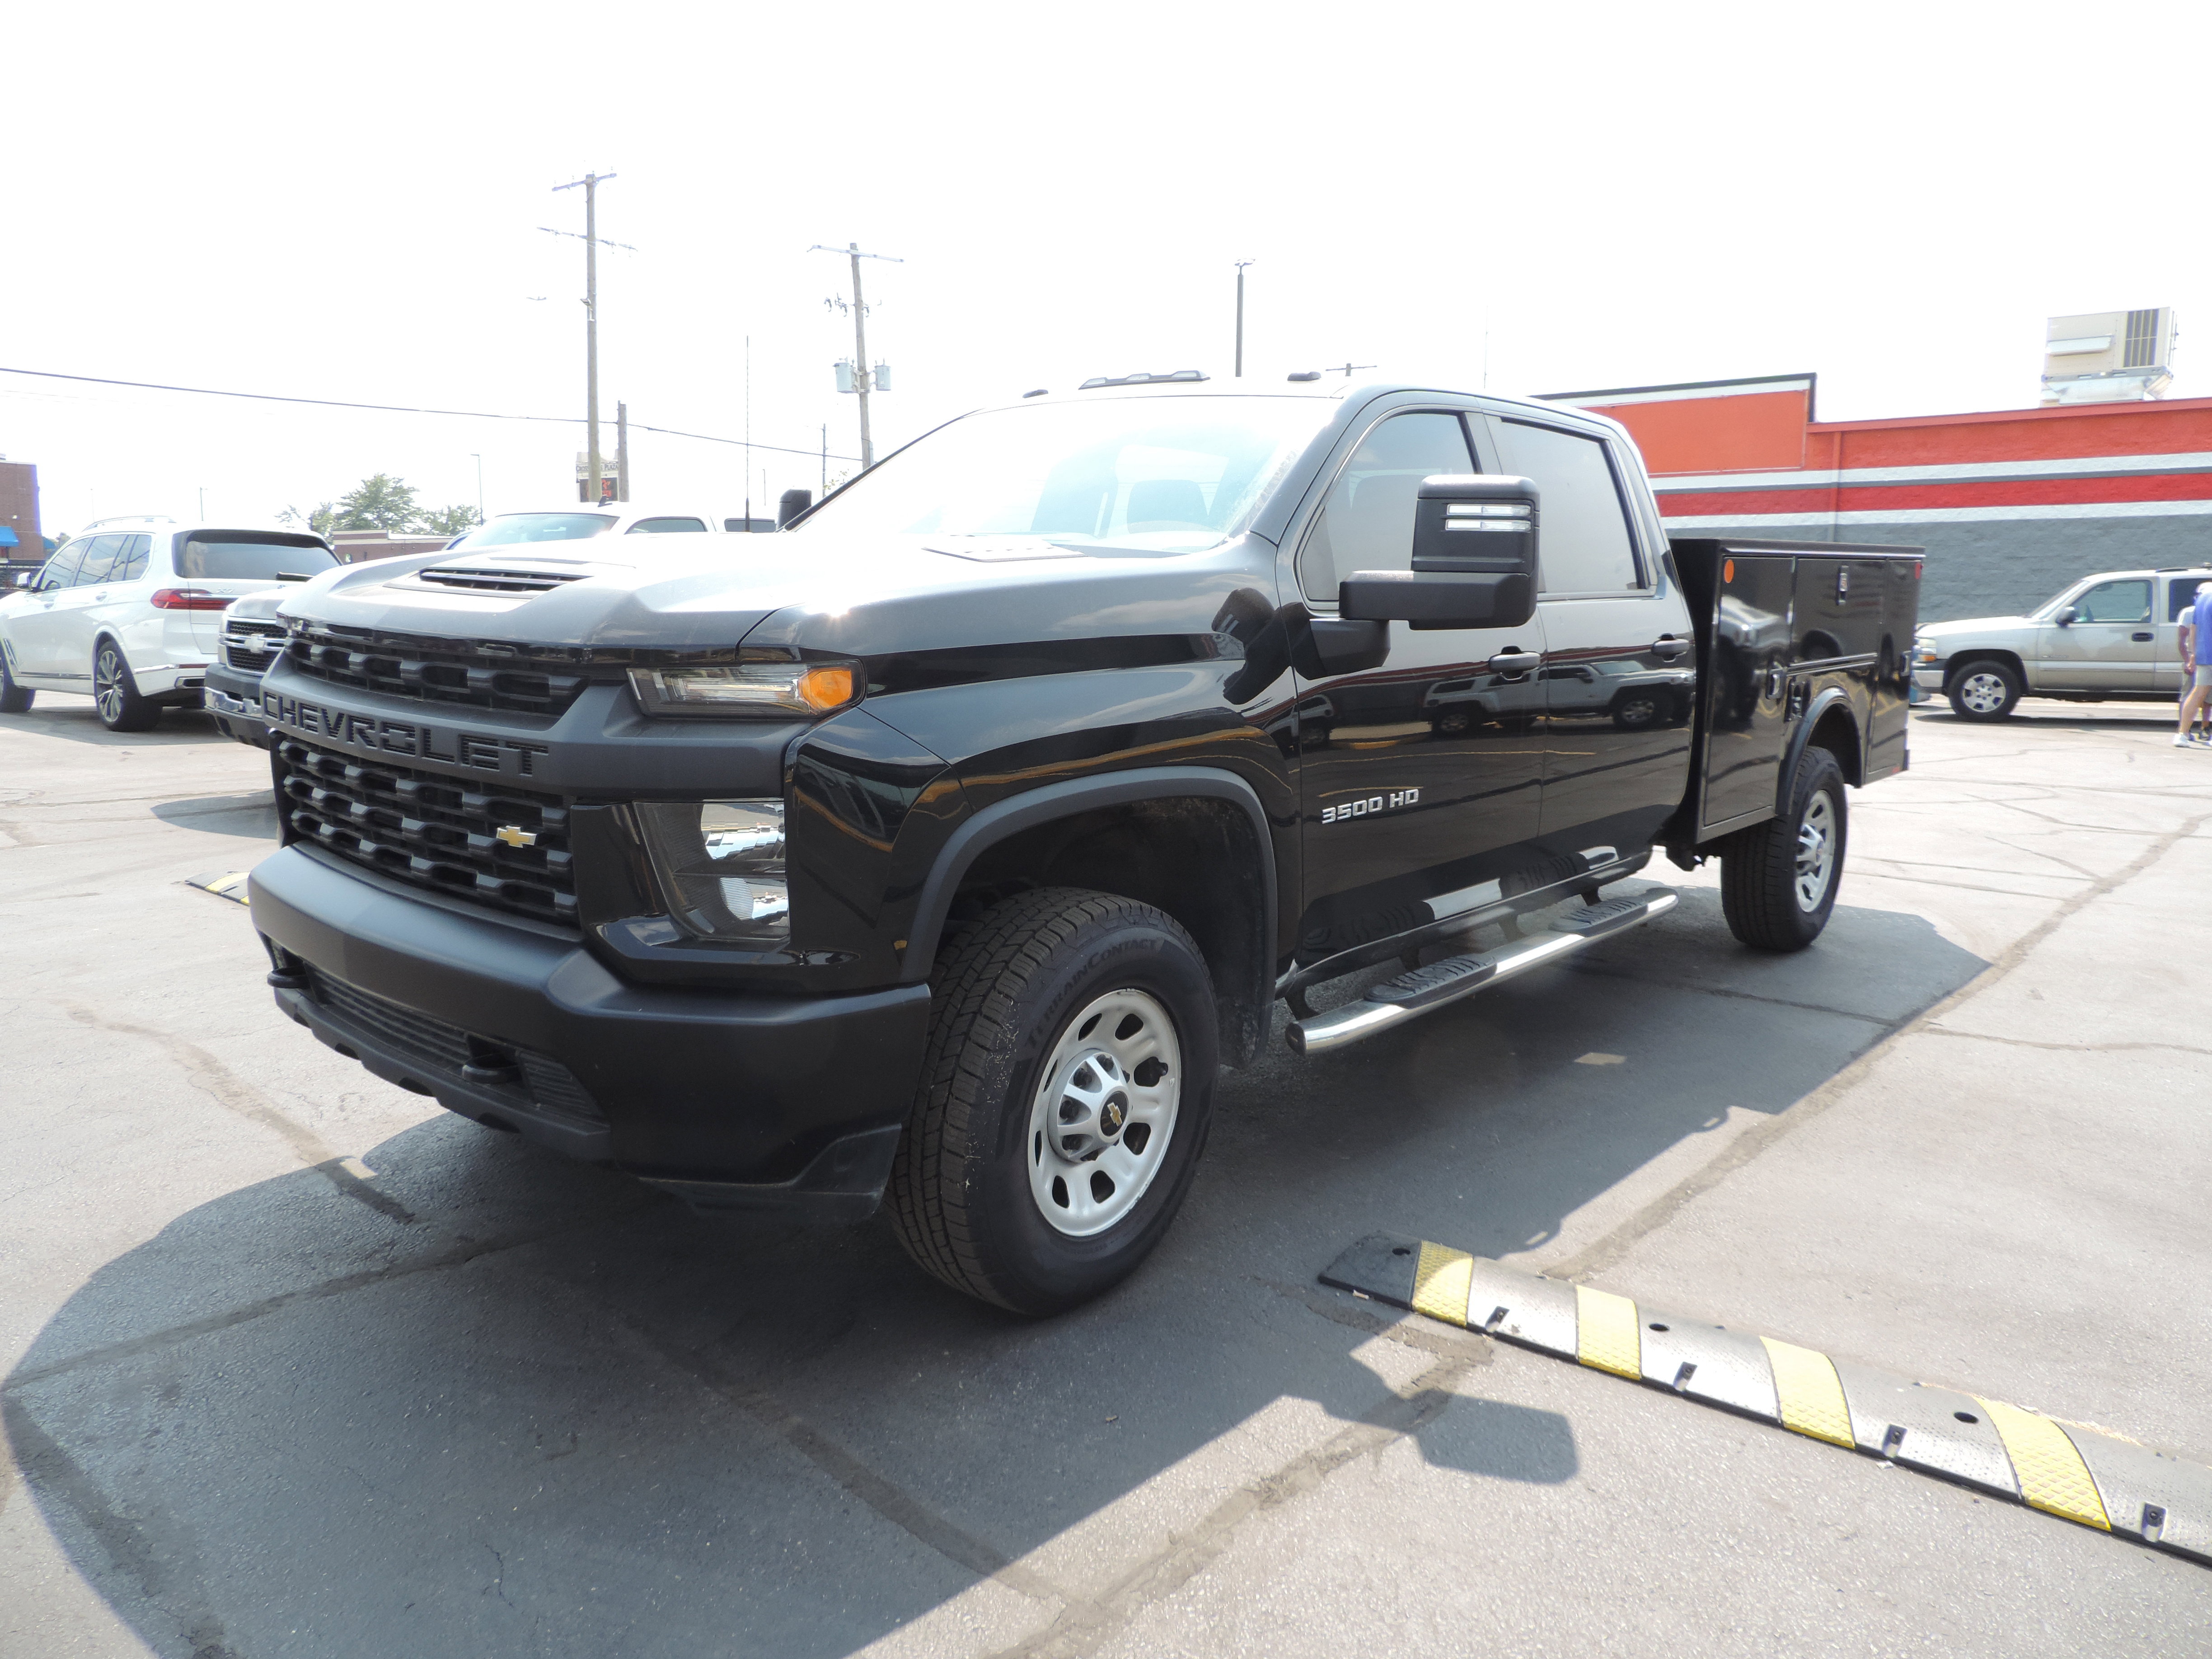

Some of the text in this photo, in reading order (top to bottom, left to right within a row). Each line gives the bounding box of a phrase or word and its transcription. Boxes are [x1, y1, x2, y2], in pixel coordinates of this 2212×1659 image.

[263, 691, 549, 777] CHEVROLET
[1322, 789, 1419, 824] 3500 HD
